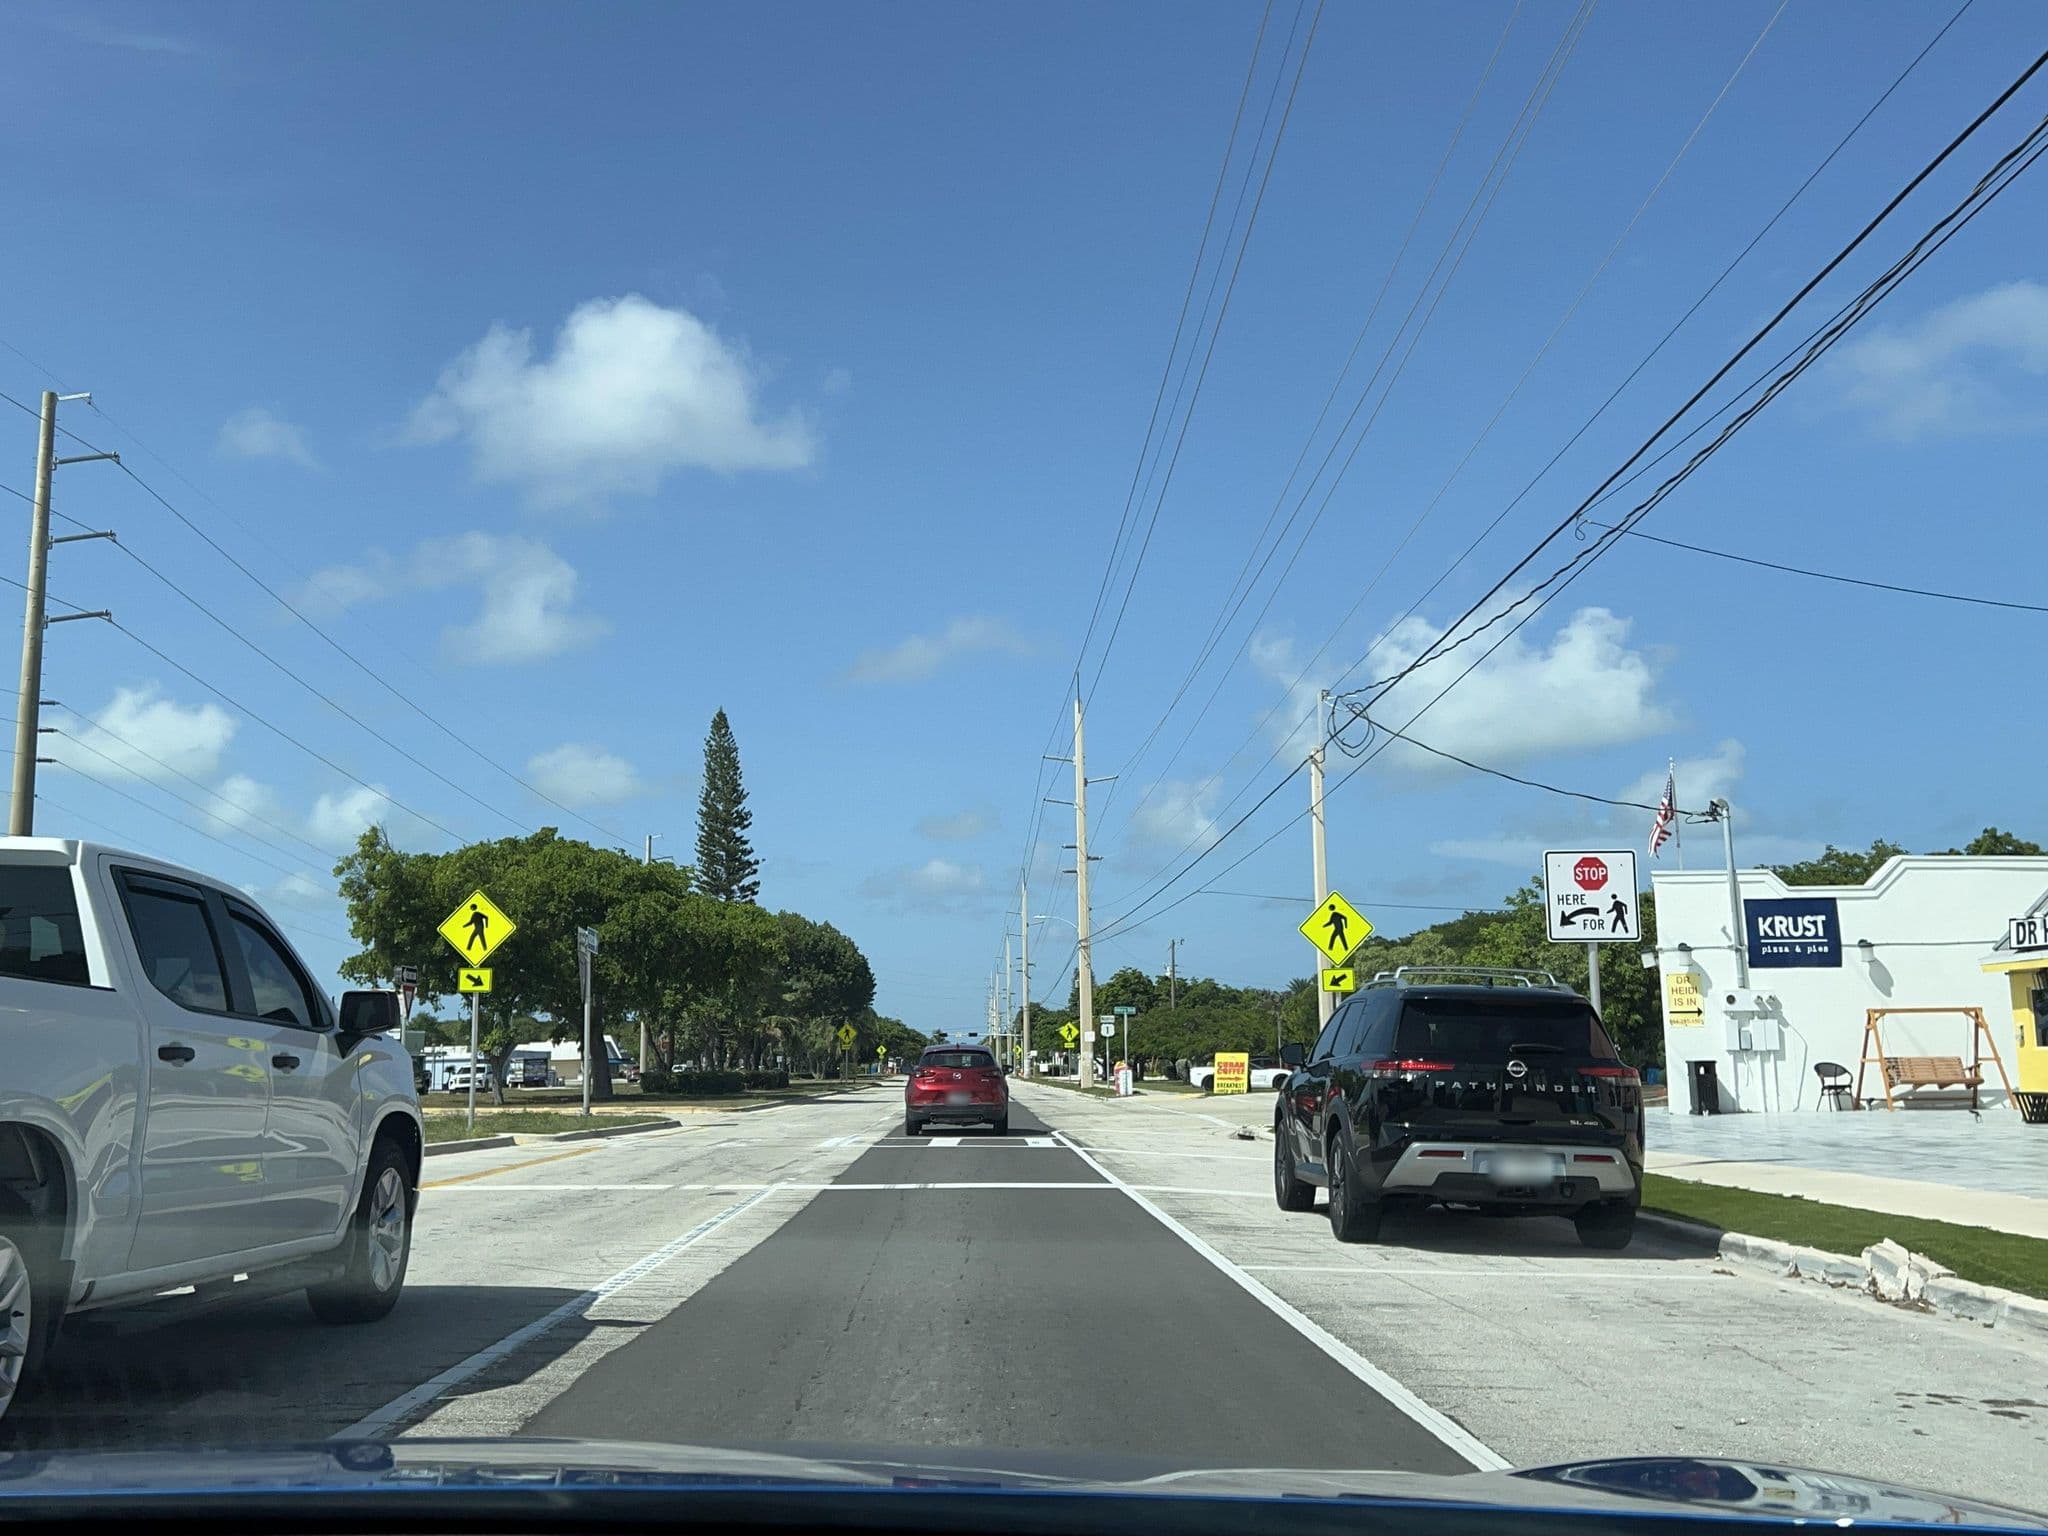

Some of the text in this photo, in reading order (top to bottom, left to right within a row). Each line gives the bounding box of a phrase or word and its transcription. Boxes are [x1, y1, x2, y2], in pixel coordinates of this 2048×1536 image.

[1575, 867, 1607, 881] STOP
[1557, 893, 1587, 906] HERE
[1583, 919, 1605, 931] FOR
[1758, 914, 1826, 937] KRUST
[2015, 920, 2038, 945] DR
[1761, 944, 1829, 955] pizza & pies
[1676, 975, 1691, 984] DR
[1671, 986, 1698, 995] HEIDI
[1674, 997, 1697, 1006] IS IN
[1435, 1080, 1598, 1094] PATHFINDER
